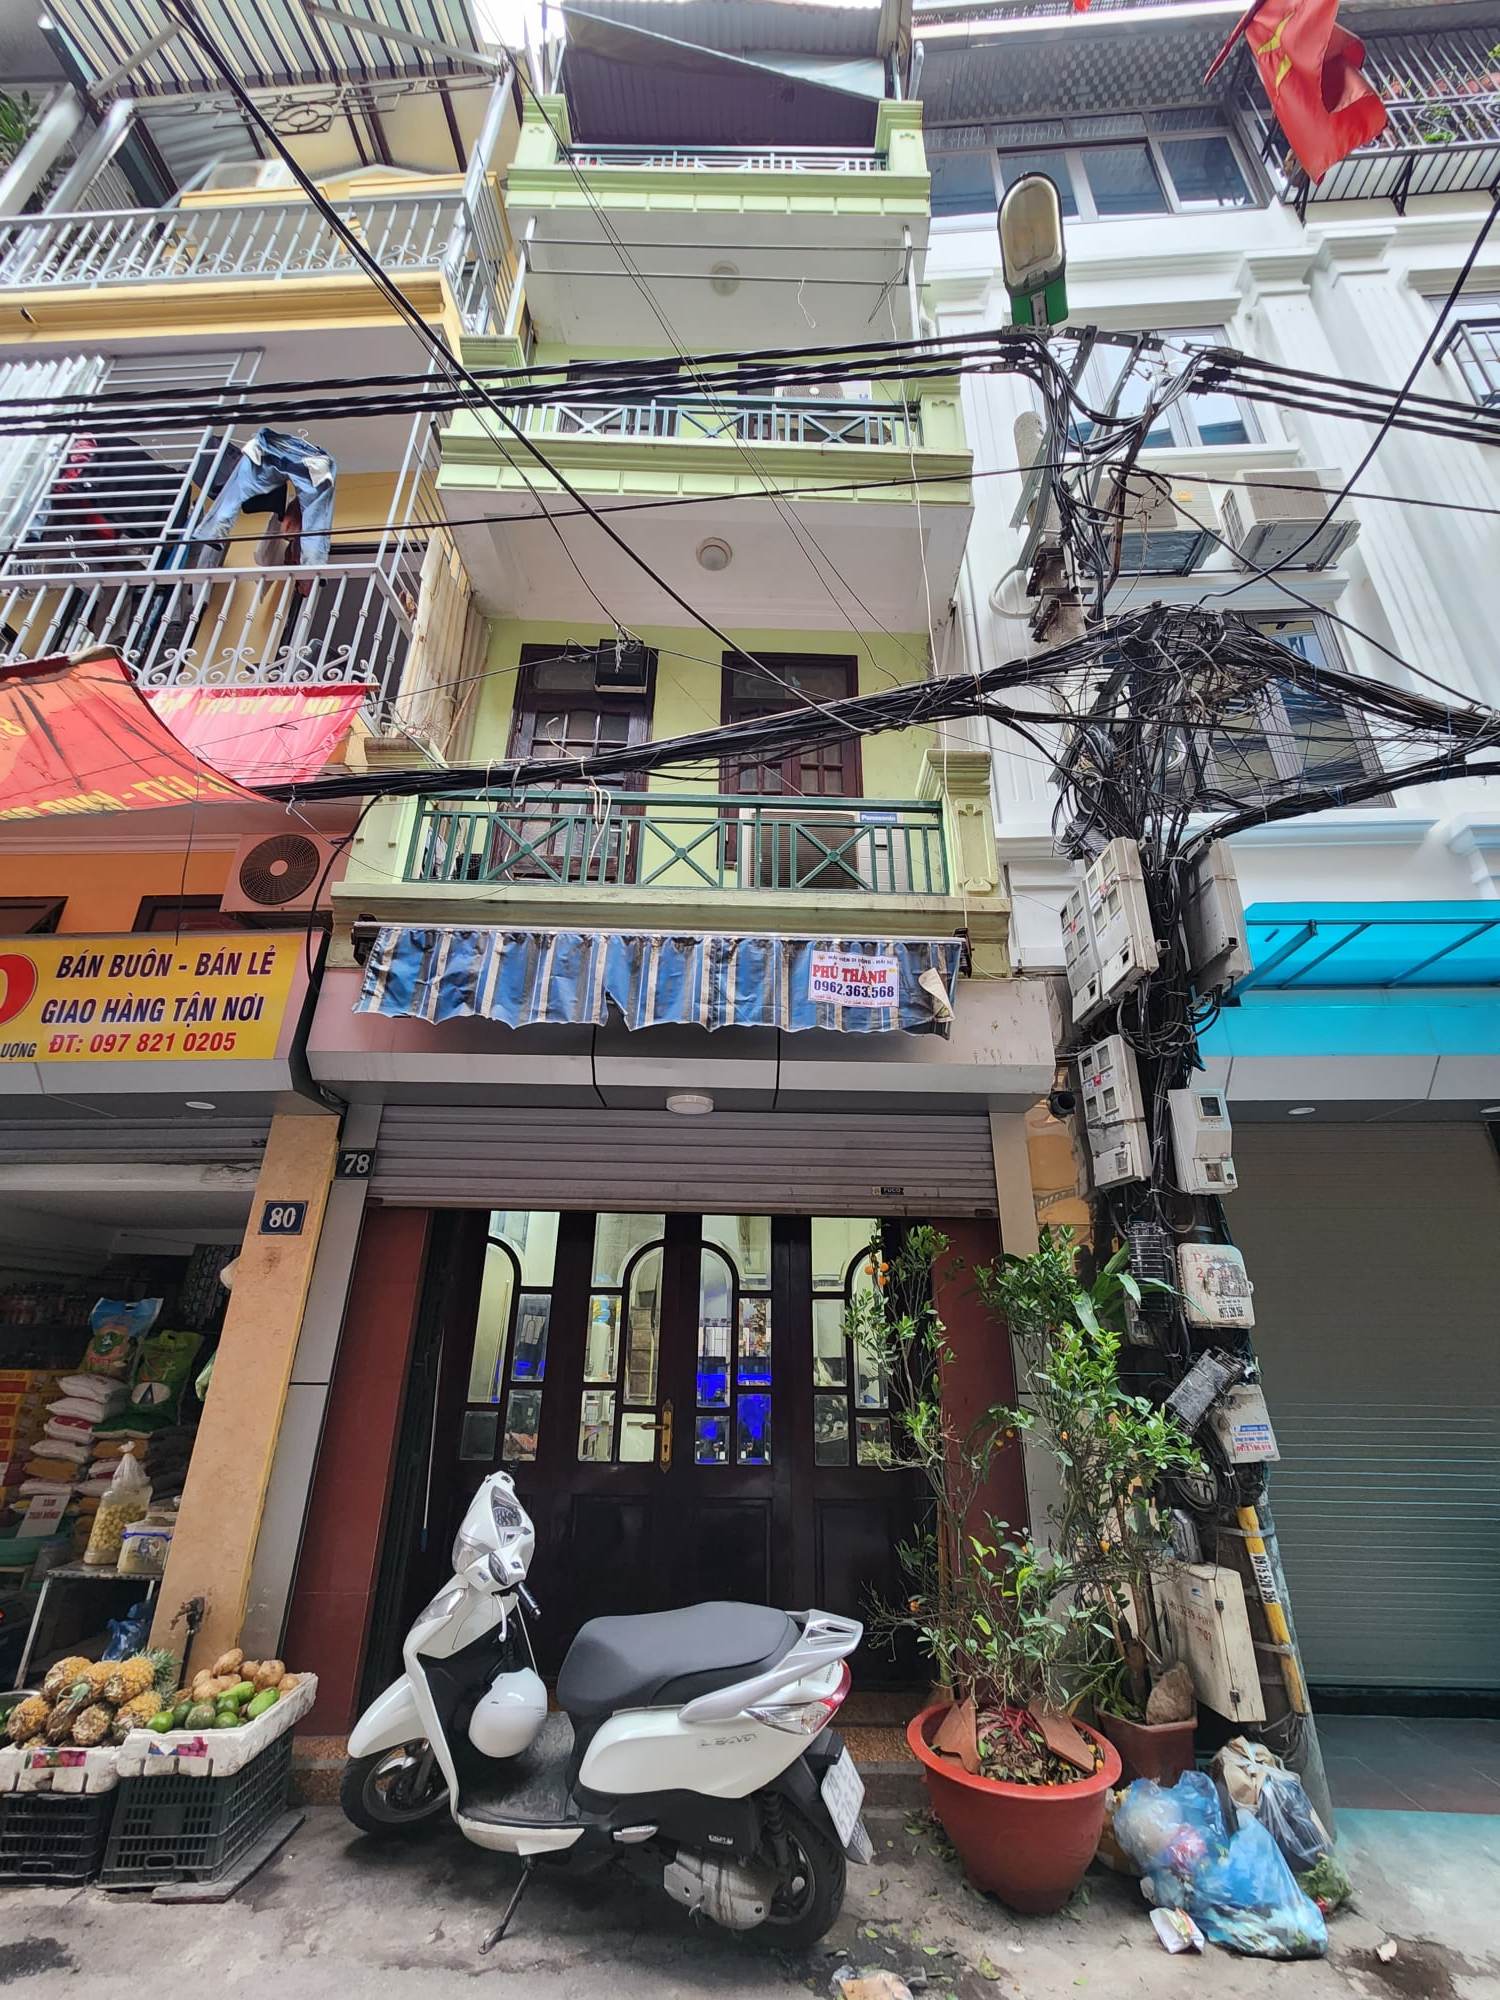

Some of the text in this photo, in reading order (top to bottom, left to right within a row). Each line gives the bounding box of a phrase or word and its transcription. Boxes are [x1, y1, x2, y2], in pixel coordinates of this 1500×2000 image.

[55, 948, 103, 979] BÁN
[108, 948, 172, 978] BUÔN
[194, 946, 242, 977] BÁN
[246, 944, 276, 975] LẺ
[814, 980, 895, 998] 0962.363.568
[41, 992, 265, 1028] GIAO HÀNG TẬN NƠI
[48, 1032, 237, 1054] ĐT: 097 821 0205
[343, 1153, 370, 1174] 78
[268, 1206, 297, 1229] 80
